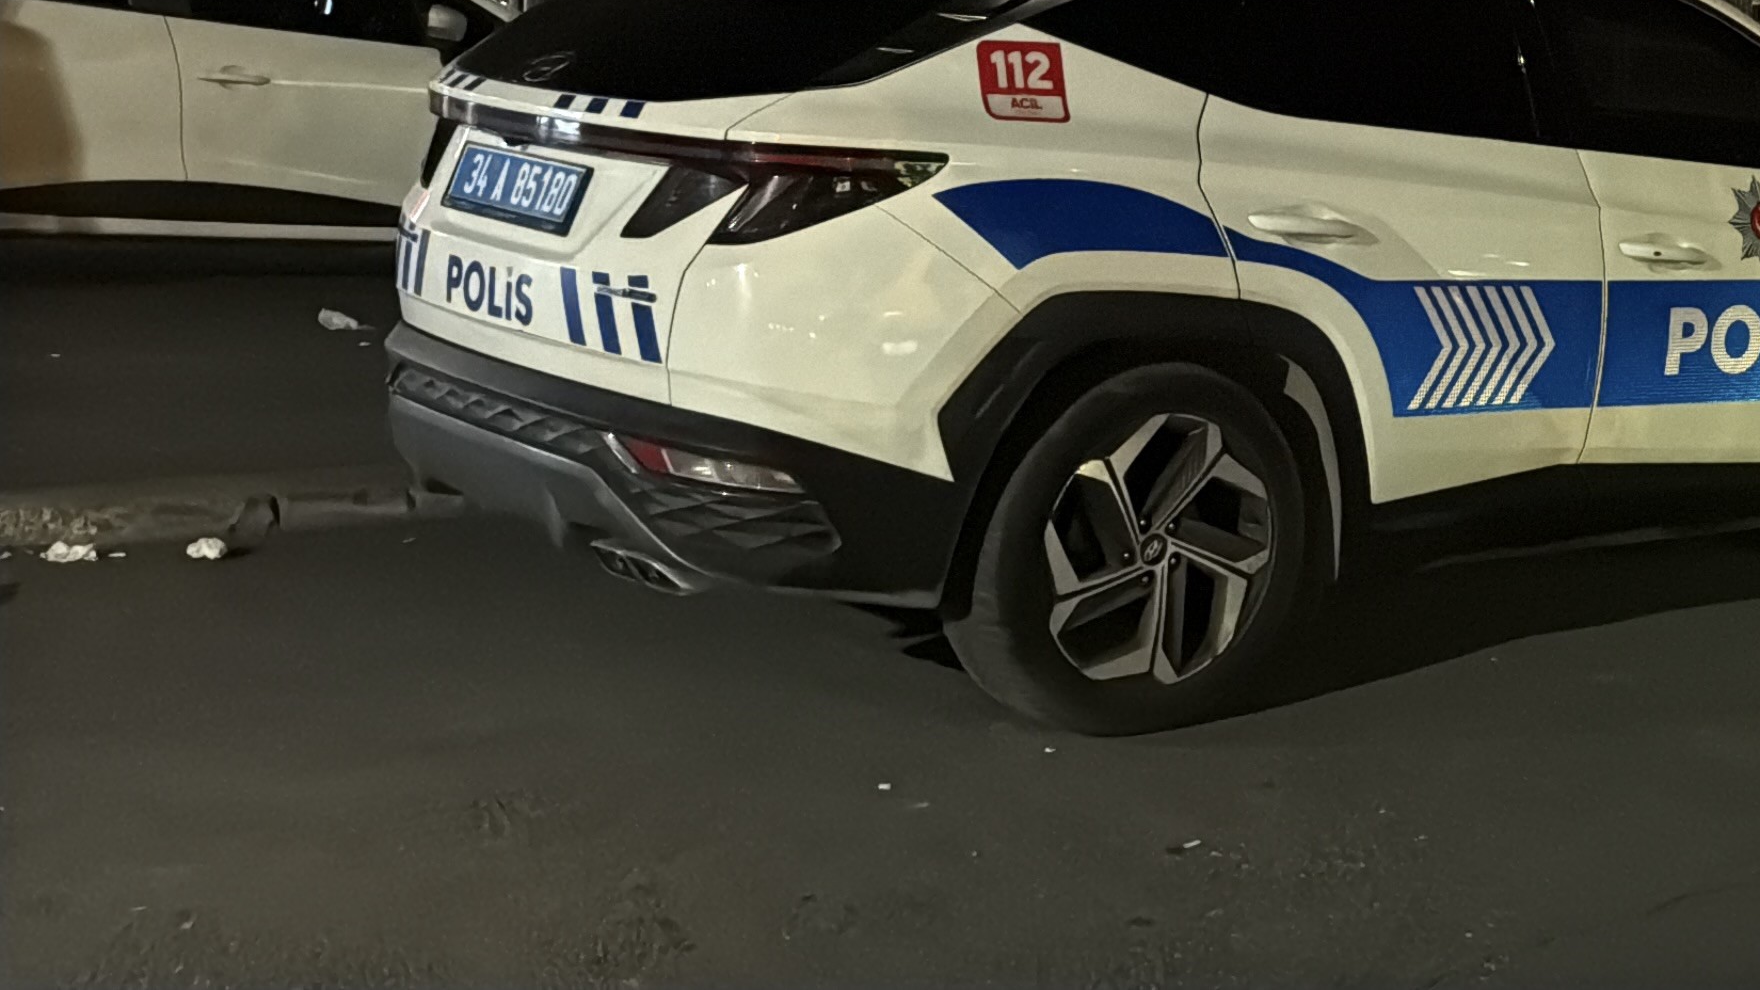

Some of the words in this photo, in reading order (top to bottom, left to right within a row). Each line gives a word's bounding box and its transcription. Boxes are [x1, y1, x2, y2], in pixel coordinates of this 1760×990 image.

[990, 50, 1054, 90] 112
[463, 153, 492, 197] 34
[490, 158, 510, 201] A
